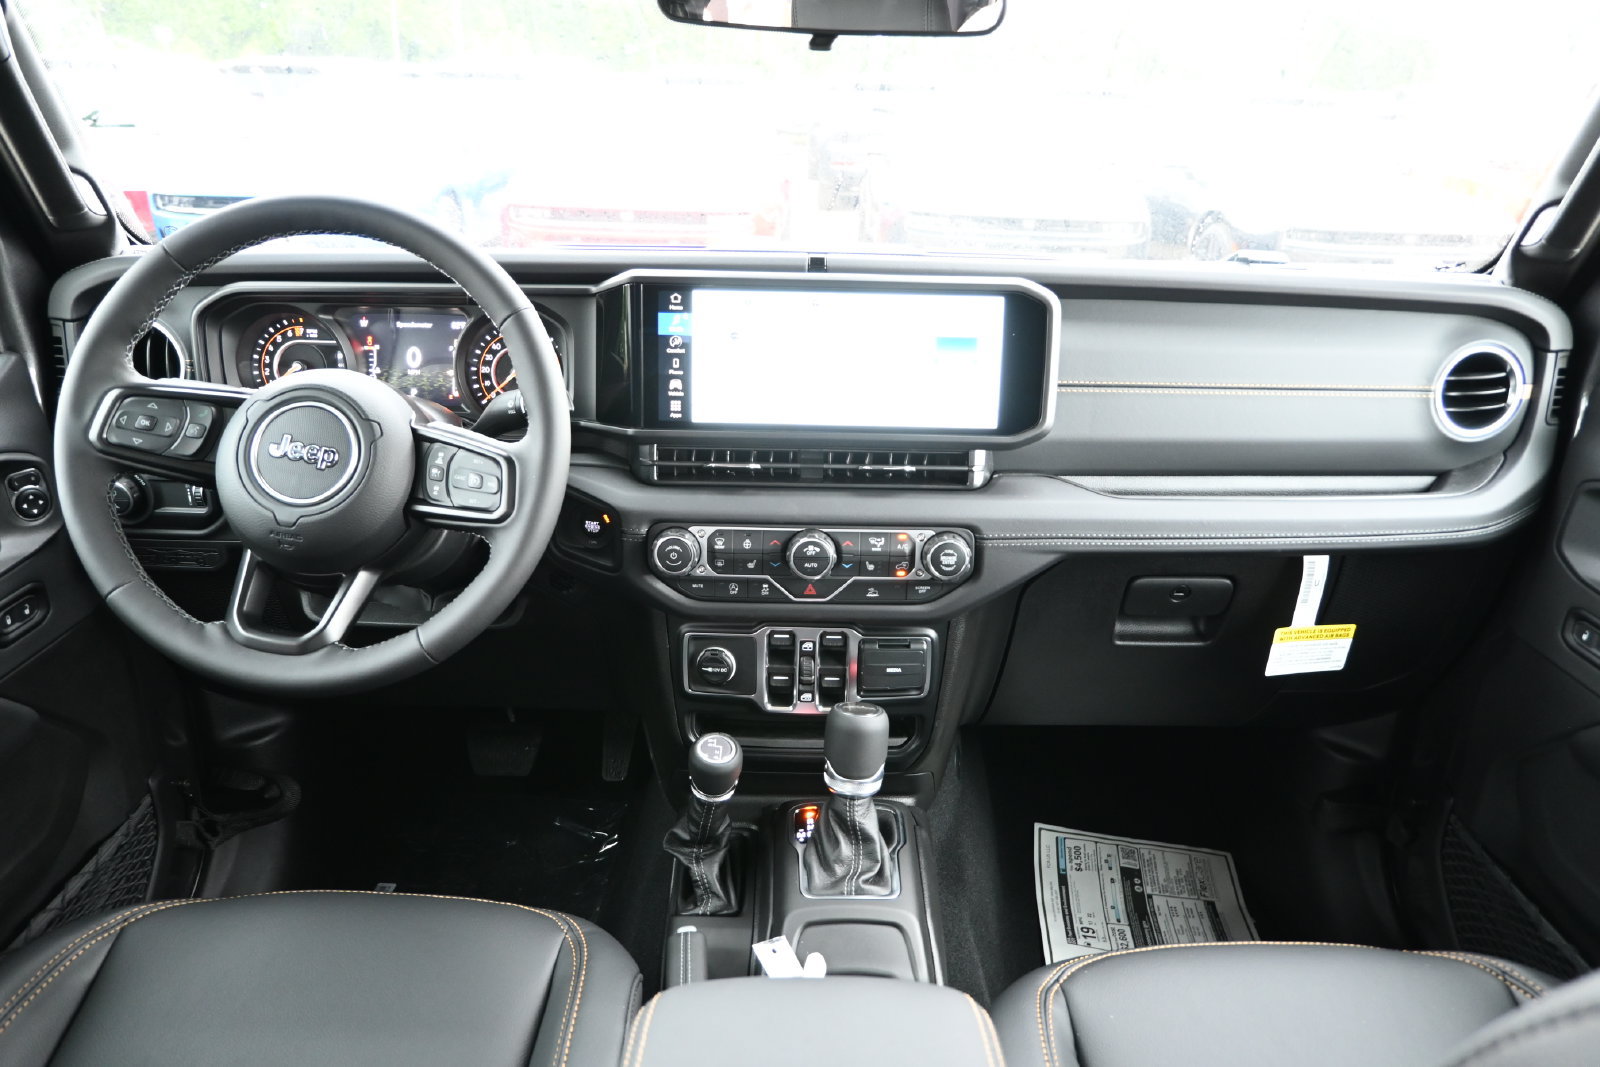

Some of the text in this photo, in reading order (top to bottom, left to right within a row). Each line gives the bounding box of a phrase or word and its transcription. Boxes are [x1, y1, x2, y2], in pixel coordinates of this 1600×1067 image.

[406, 346, 422, 368] 0
[268, 433, 340, 471] Jeep
[1074, 845, 1083, 872] $4,500
[1080, 926, 1096, 939] 19
